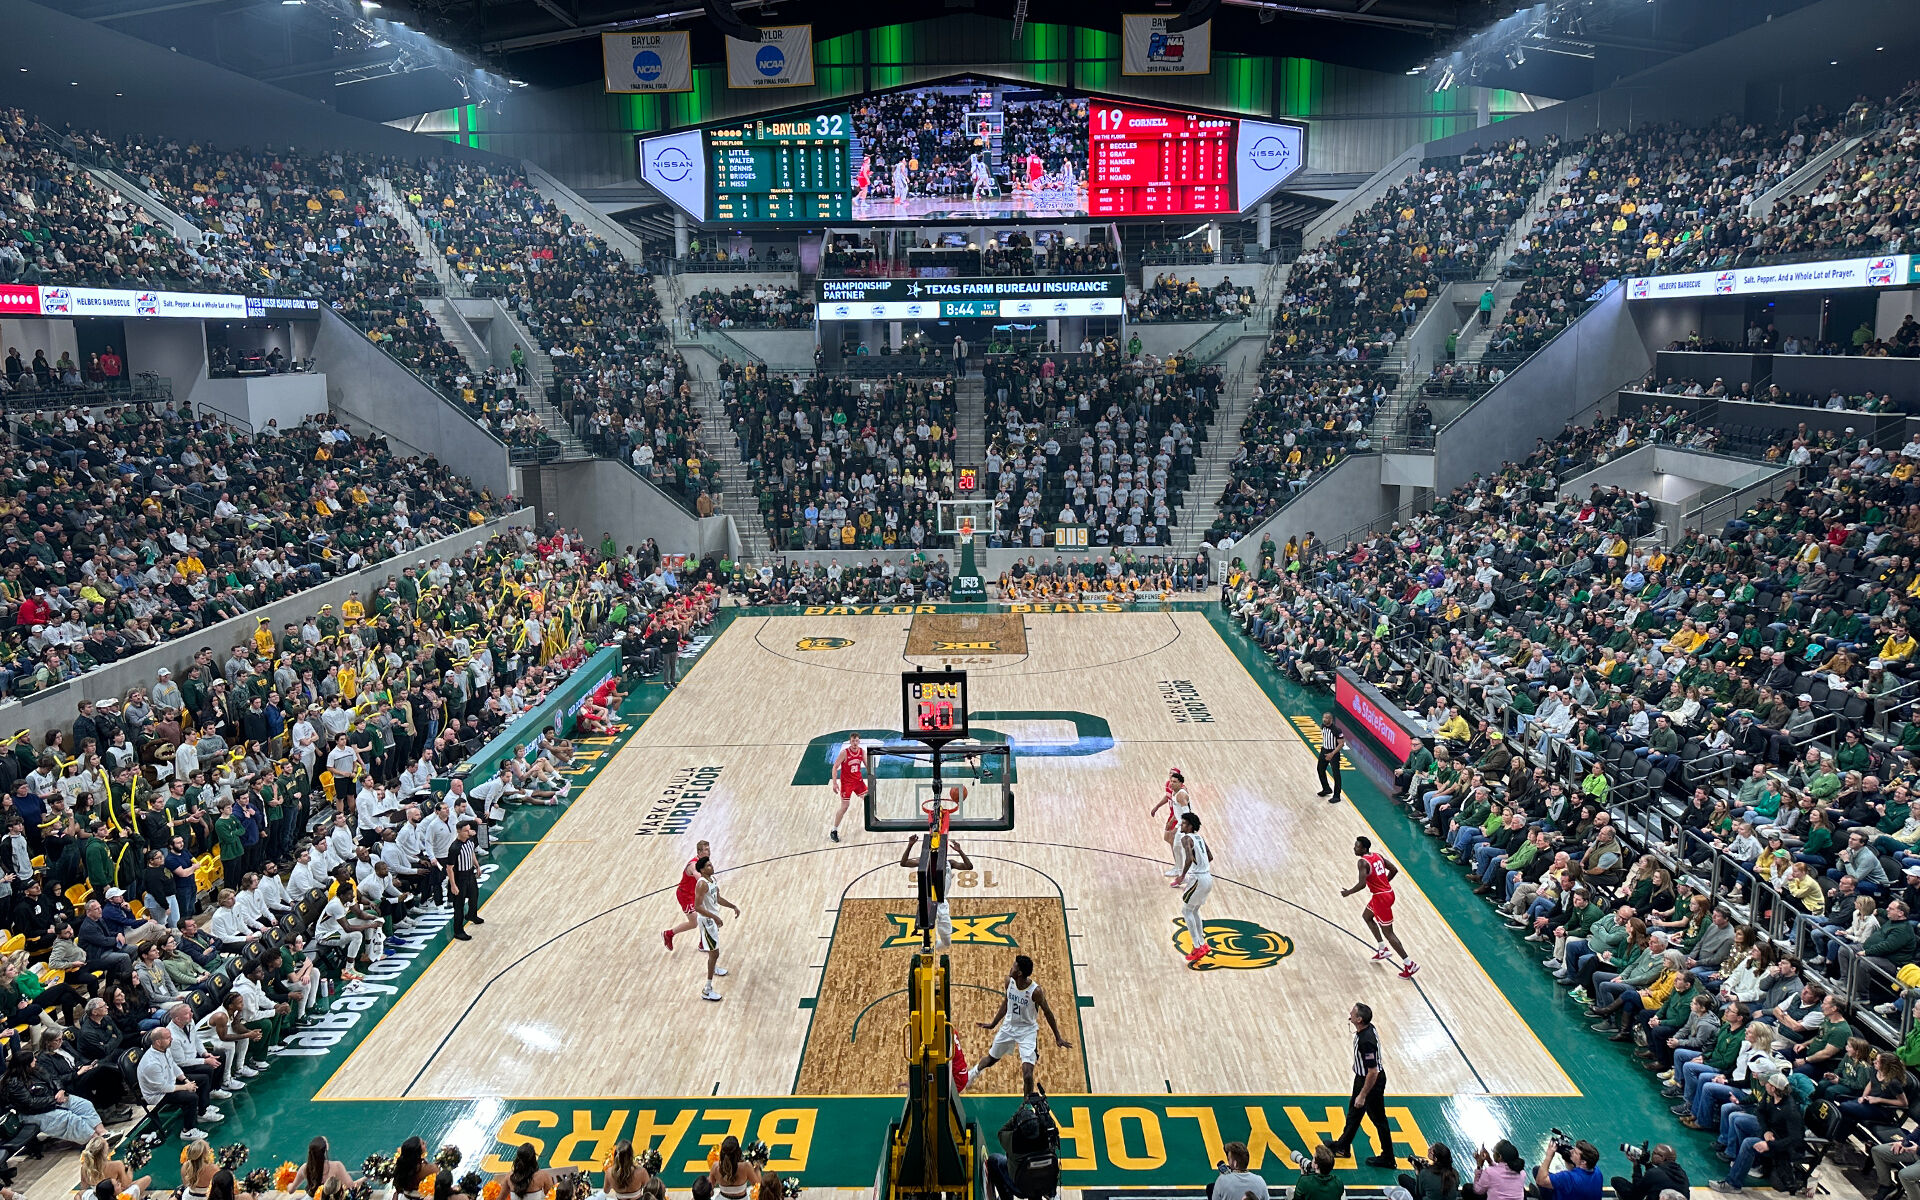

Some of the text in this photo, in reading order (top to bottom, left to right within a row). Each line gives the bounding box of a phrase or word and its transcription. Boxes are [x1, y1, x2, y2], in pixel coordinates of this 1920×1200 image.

[1152, 18, 1168, 27] BAY
[631, 36, 661, 45] BAYLOR
[760, 30, 783, 40] AYLOR
[636, 65, 662, 74] NCAA
[759, 60, 784, 69] NCAA
[772, 115, 843, 136] BAYLOR 32
[1097, 109, 1168, 130] 19 CORNELL
[1249, 149, 1290, 158] NISSAN
[653, 160, 693, 168] NISSAN
[1778, 273, 1789, 282] And
[1794, 272, 1812, 281] Whole
[1813, 271, 1823, 280] Lot
[1824, 270, 1831, 279] of
[1832, 269, 1855, 279] Prayer.
[823, 281, 1109, 295] CHAMPIONSHIP TEXAS FARM BUREAU INSURANCE
[1658, 281, 1701, 290] HELBERG BARBECUE
[823, 291, 865, 300] PARTNER
[77, 298, 130, 307] HELBERG BARBECUE
[946, 304, 975, 316] 8:44
[961, 469, 976, 477] 8:44
[959, 477, 974, 489] 20
[803, 604, 1122, 615] BAYLOR BEARS
[939, 657, 993, 665] 1845
[1172, 680, 1215, 723] HURD FLOOR
[918, 701, 953, 730] 20
[634, 806, 672, 836] MARK
[663, 767, 698, 795] PAULA
[658, 765, 725, 835] HURD FLOOR
[1373, 860, 1386, 875] 23
[1008, 992, 1029, 1006] BAYLOR
[1013, 1003, 1021, 1016] 21
[482, 1108, 818, 1173] BEARS
